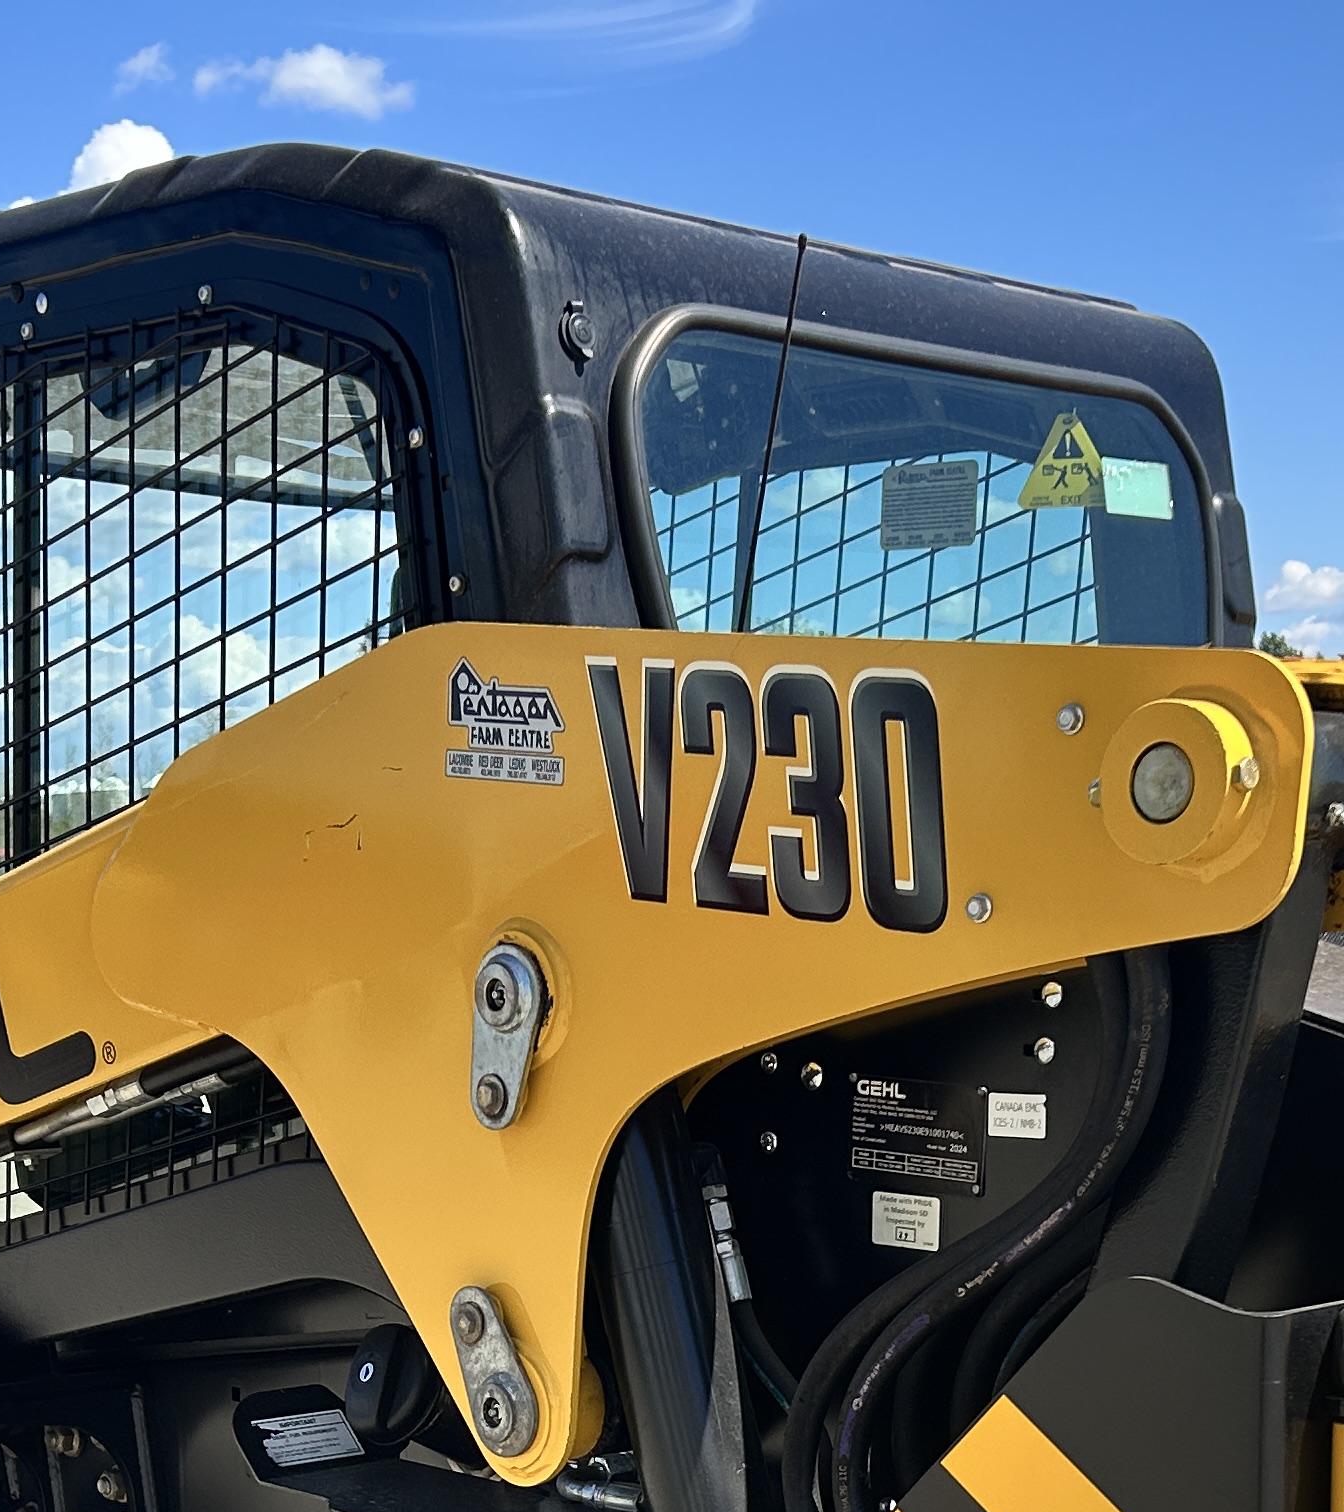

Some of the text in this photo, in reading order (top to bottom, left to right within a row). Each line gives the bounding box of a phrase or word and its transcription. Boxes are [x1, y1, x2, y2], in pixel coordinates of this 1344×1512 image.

[1060, 494, 1082, 505] EXIT
[450, 660, 562, 728] Pentagon
[470, 726, 551, 749] FARM CENTRE
[584, 655, 949, 934] V230
[856, 1079, 907, 1100] GEHL
[994, 1100, 1024, 1113] CANADA
